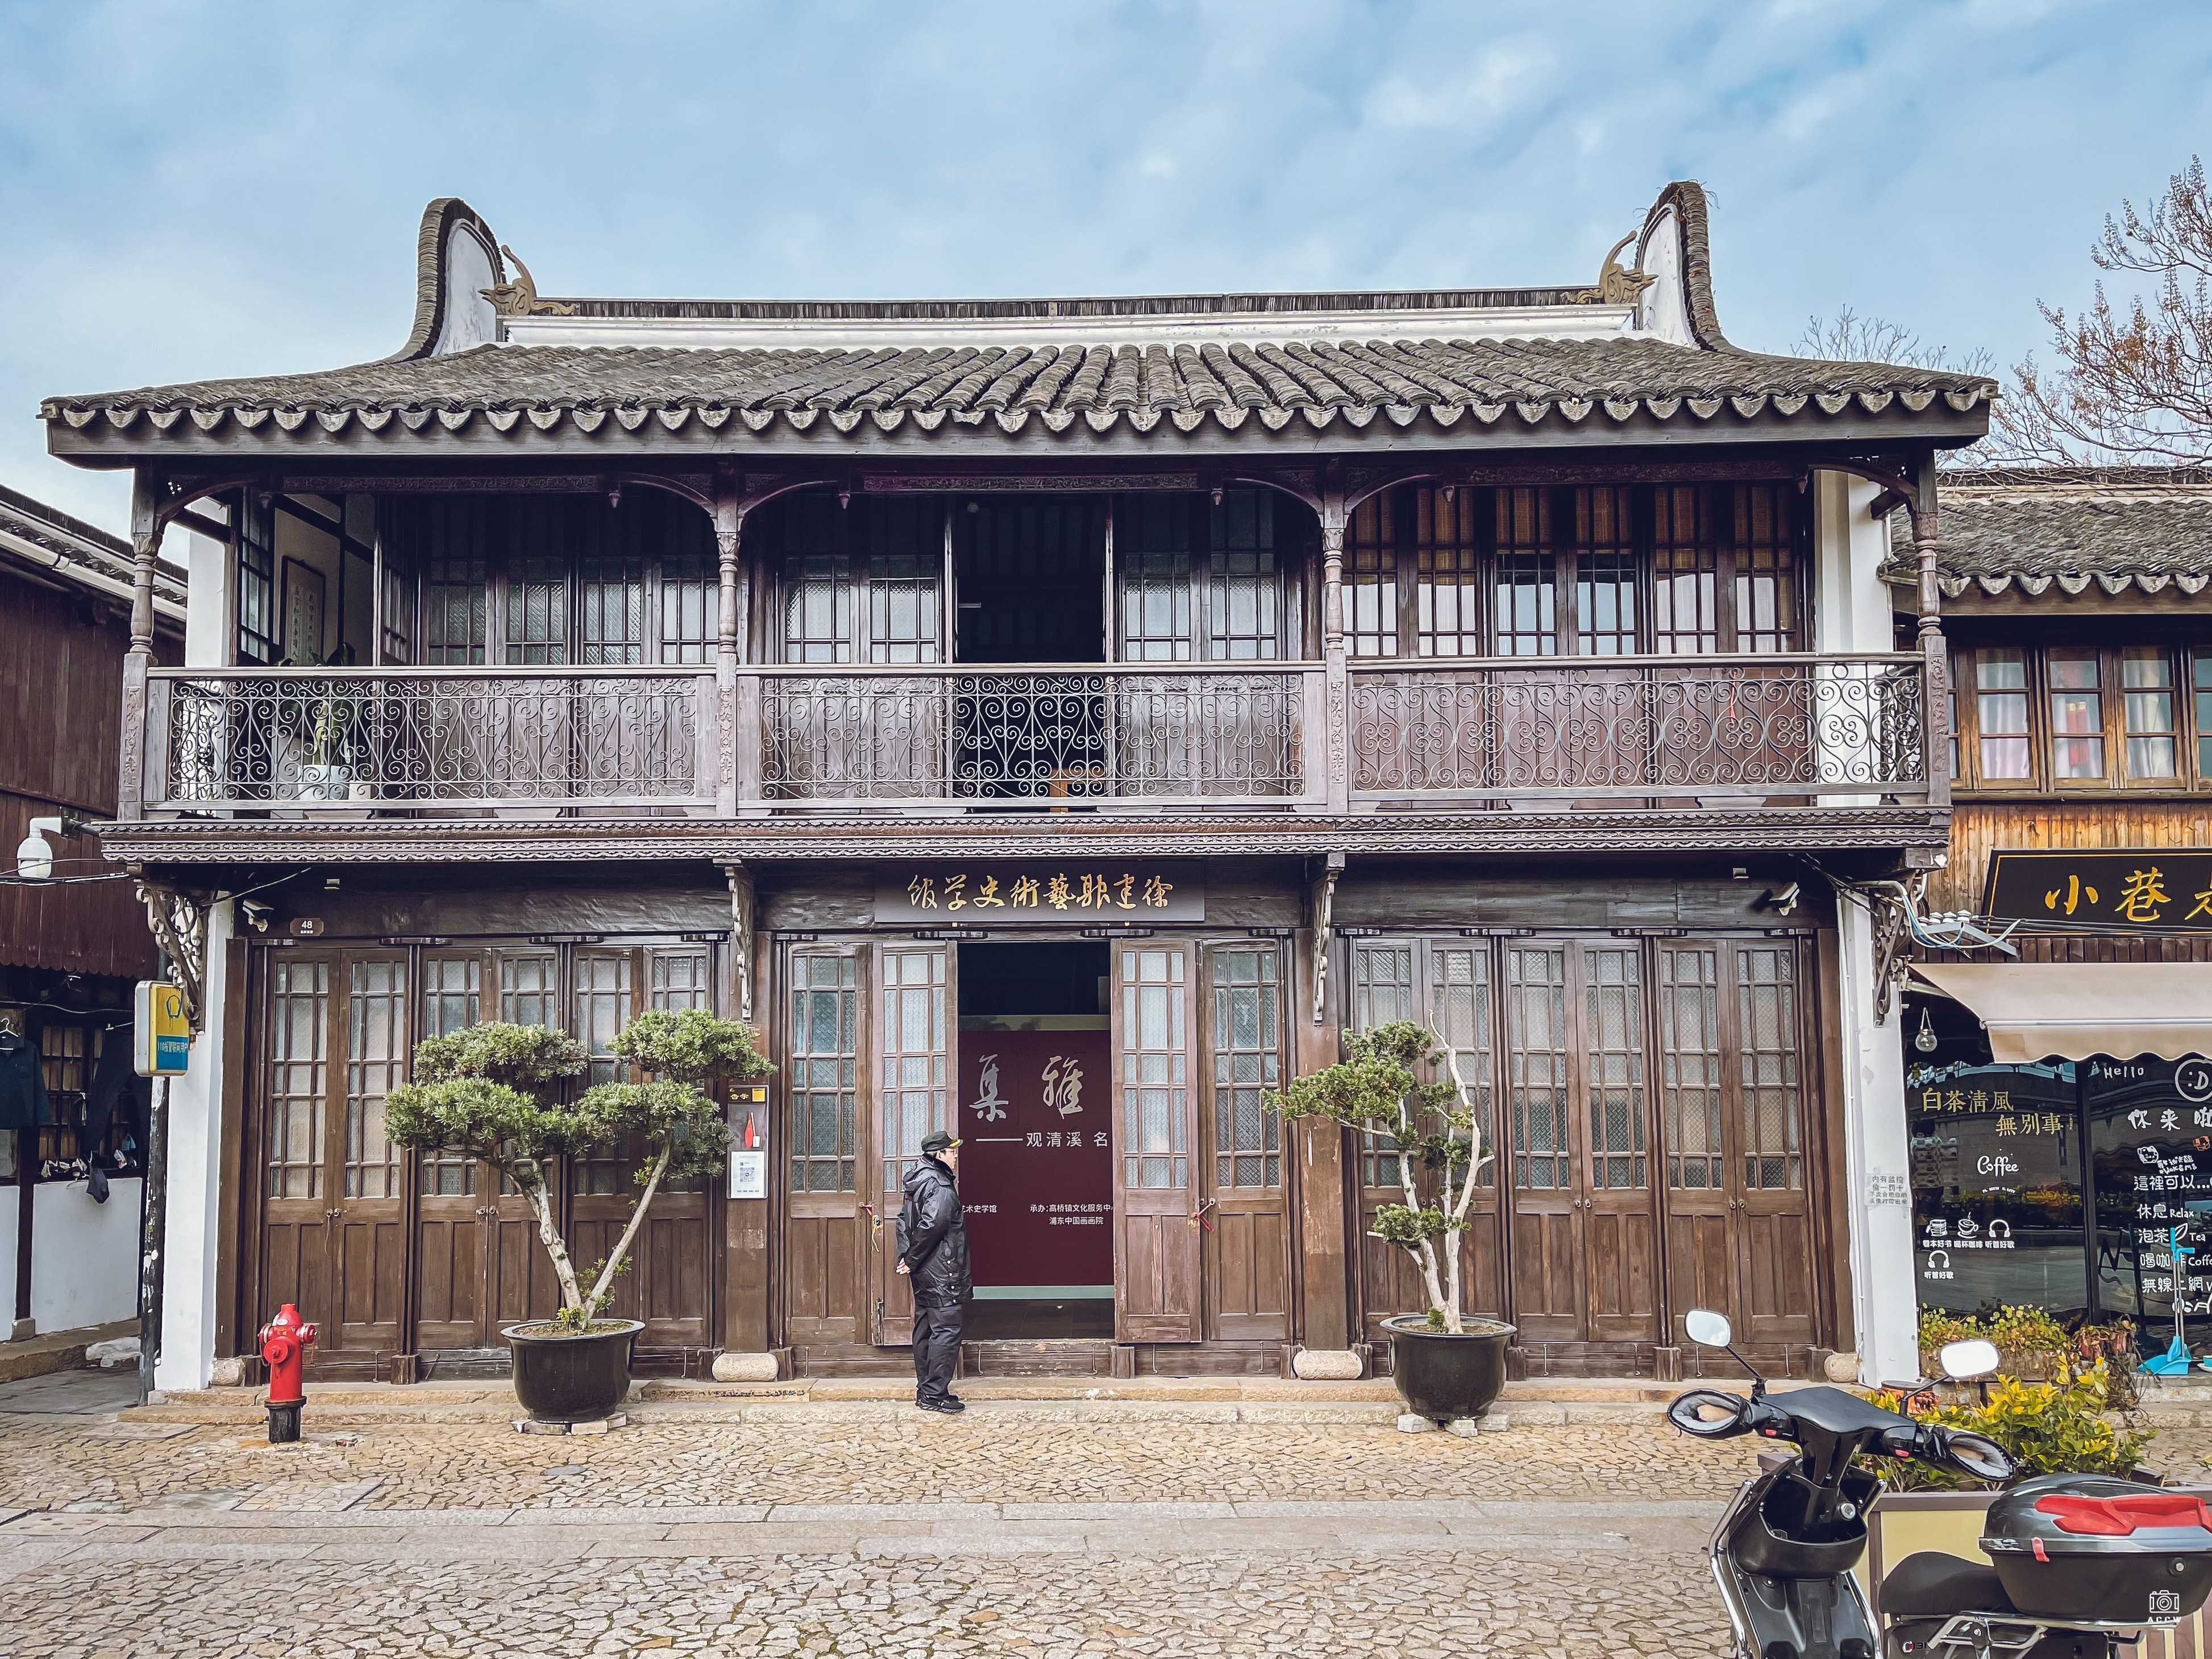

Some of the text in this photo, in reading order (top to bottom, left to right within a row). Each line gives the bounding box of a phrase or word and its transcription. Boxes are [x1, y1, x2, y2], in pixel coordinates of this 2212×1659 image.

[301, 920, 313, 929] 48
[2103, 1066, 2144, 1079] Hello
[1977, 1155, 2019, 1177] Coffee
[1030, 1204, 1113, 1213] 承办:高桥镇文化服务中
[2137, 1203, 2194, 1219] 休息 Relax
[2139, 1228, 2206, 1244] 泡茶 Tea
